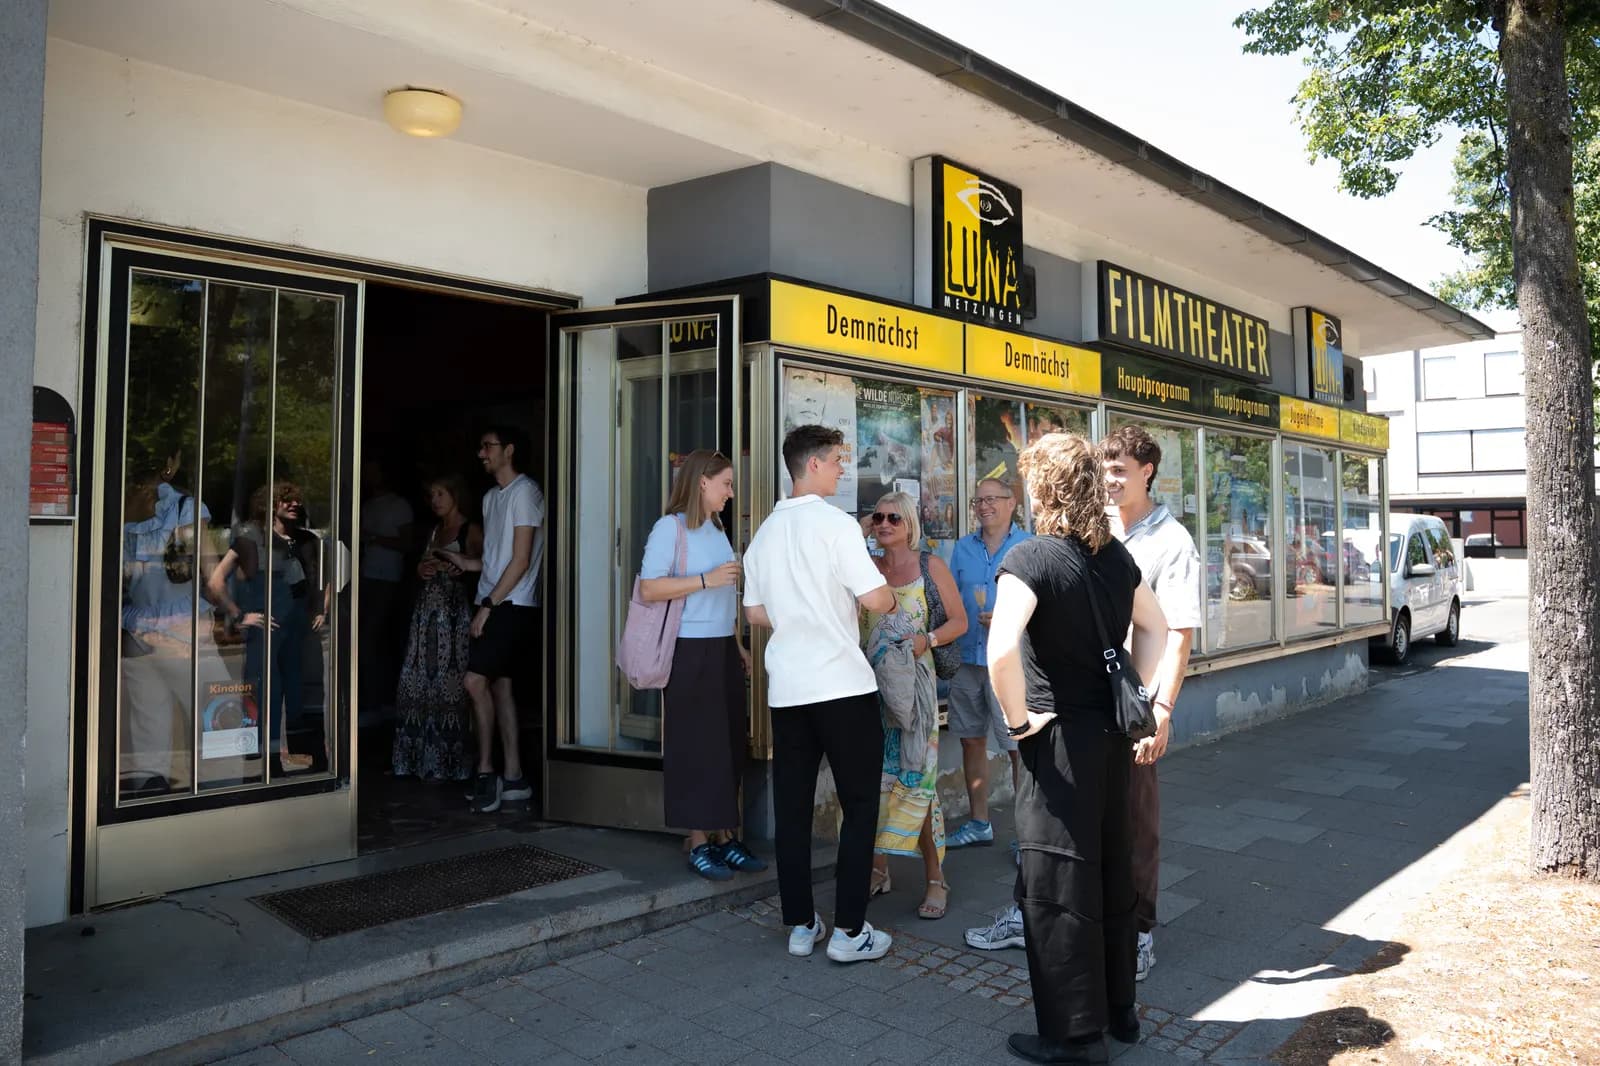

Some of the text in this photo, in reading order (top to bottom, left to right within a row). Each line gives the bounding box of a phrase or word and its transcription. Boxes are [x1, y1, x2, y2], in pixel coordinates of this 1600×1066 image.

[946, 220, 1021, 309] LUNA
[827, 304, 919, 350] Demnächst
[944, 295, 1022, 325] METZINGEN
[1108, 268, 1271, 377] FILMTHEATER
[670, 319, 714, 343] UNA
[1005, 342, 1070, 379] Demnächst
[863, 388, 887, 402] WILDE
[1117, 366, 1190, 402] Hauptprogramm
[1214, 389, 1270, 417] Hauptprogramm
